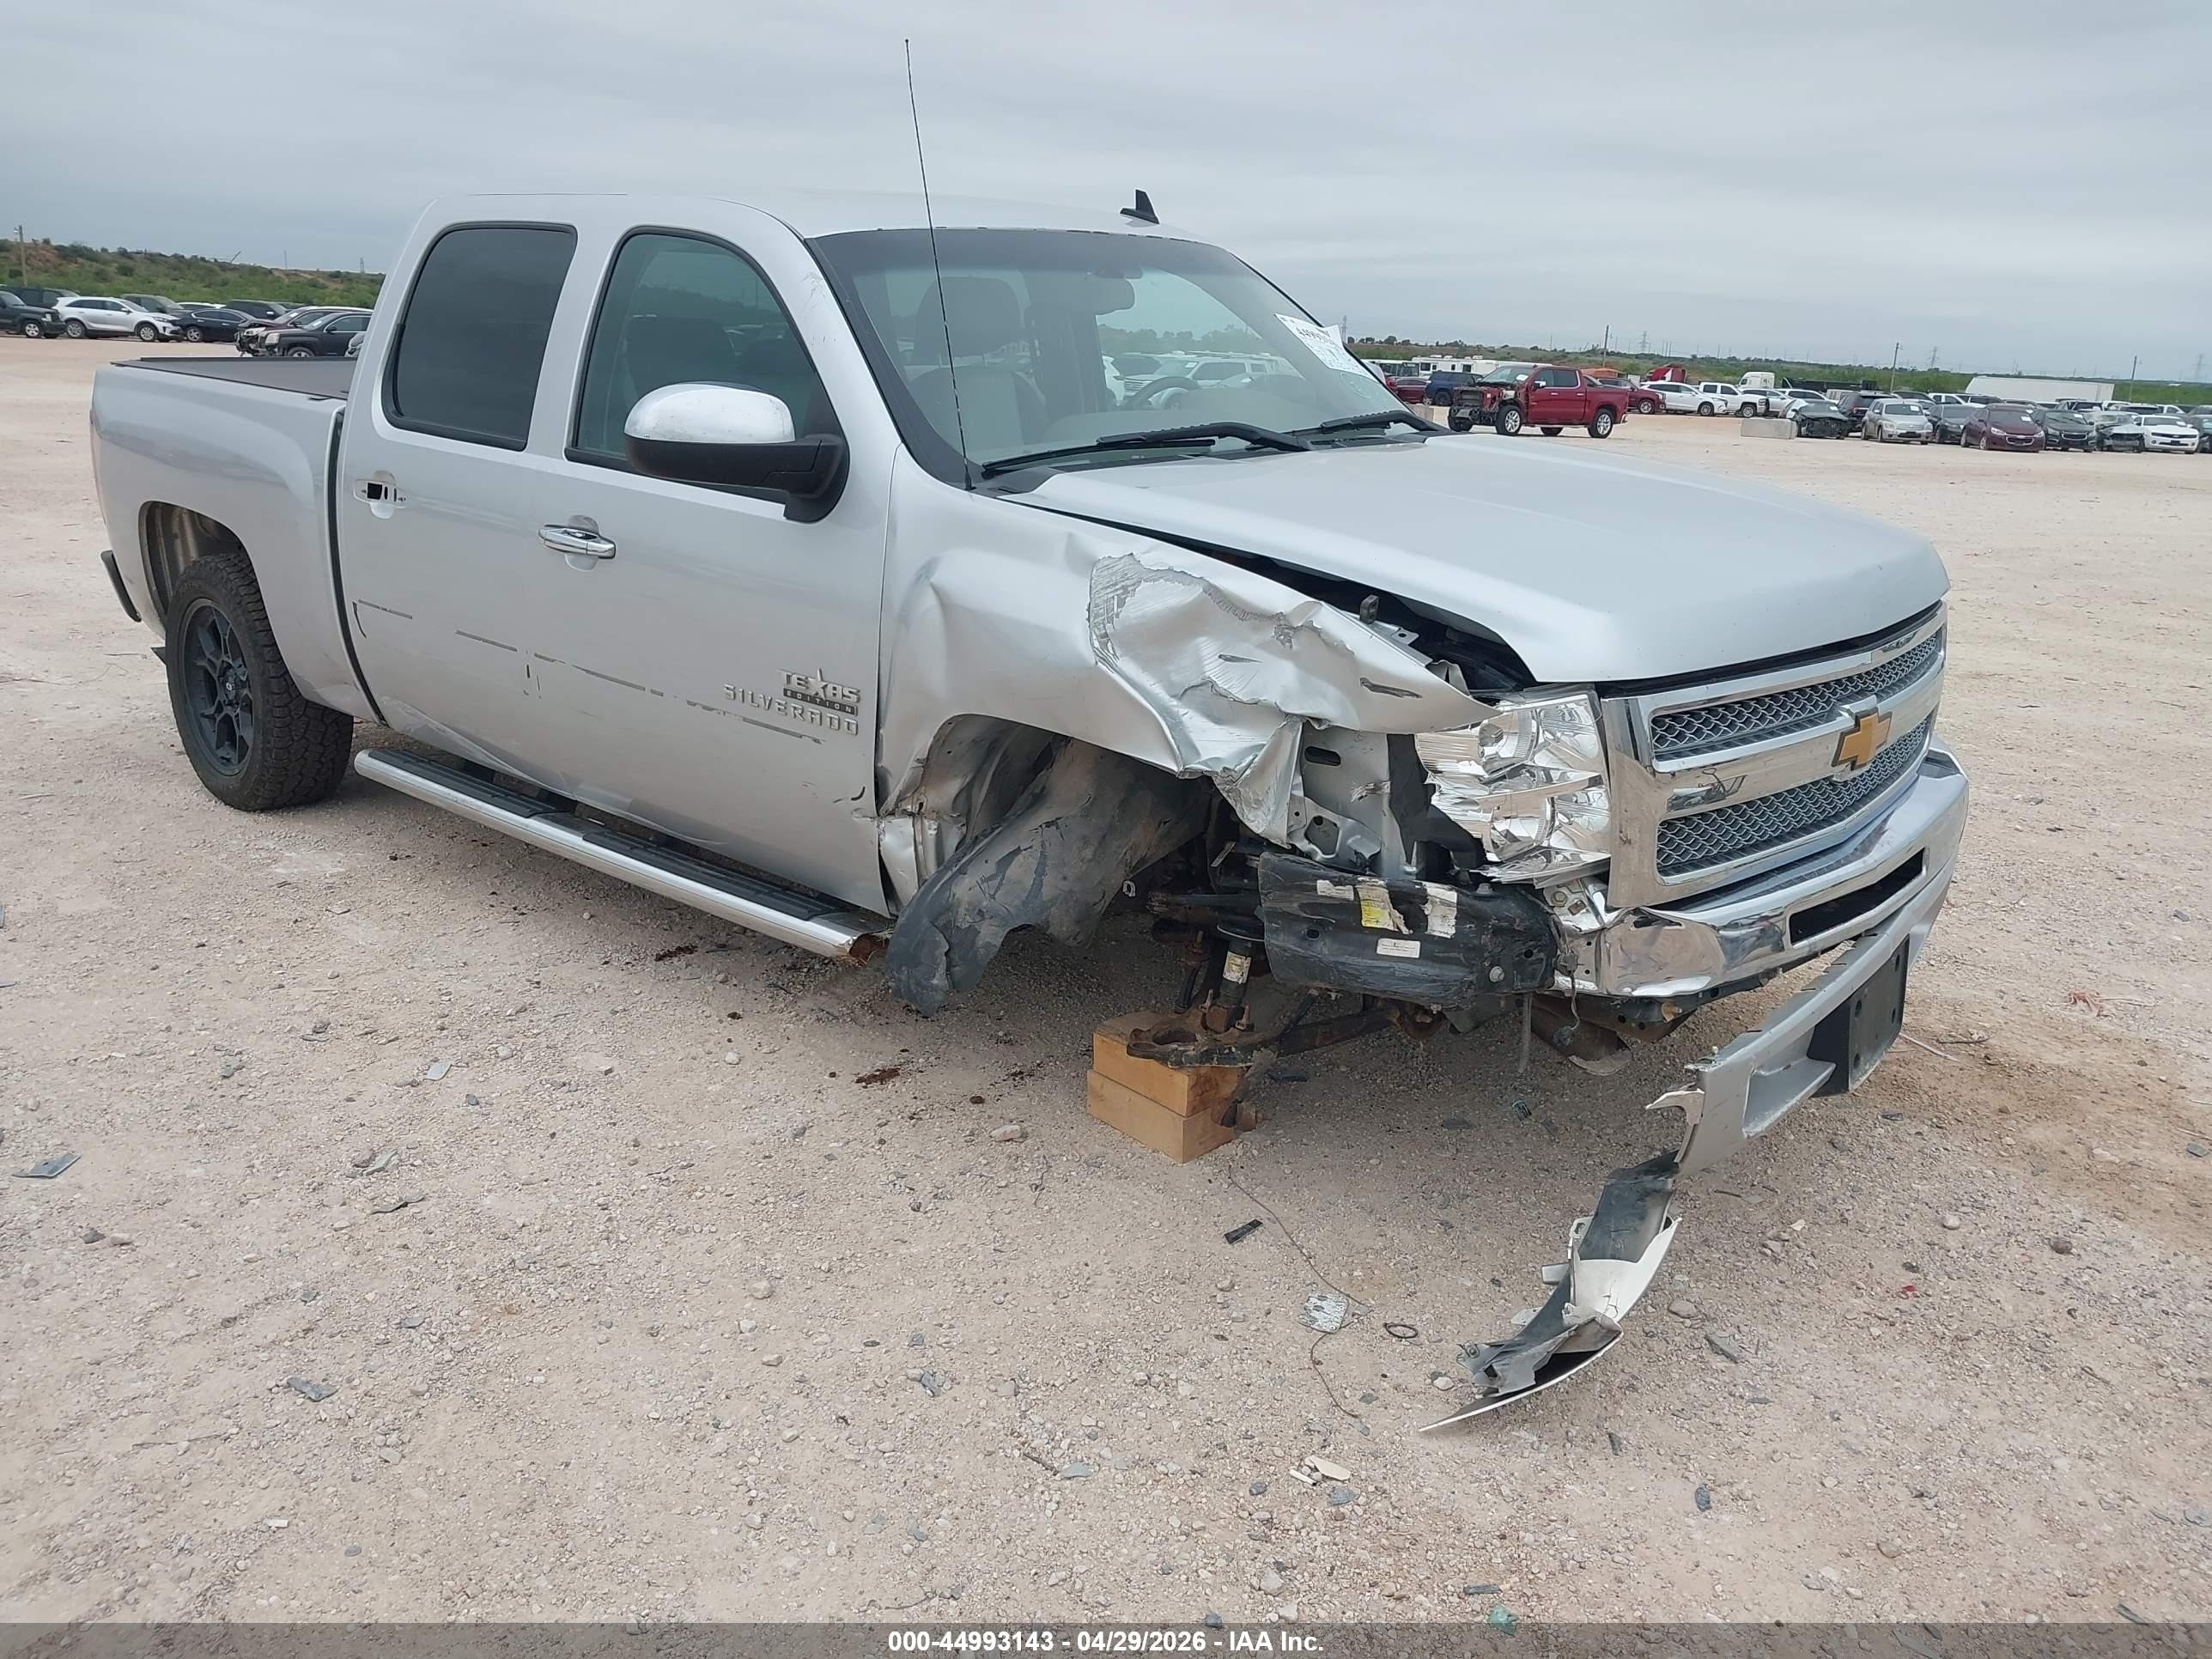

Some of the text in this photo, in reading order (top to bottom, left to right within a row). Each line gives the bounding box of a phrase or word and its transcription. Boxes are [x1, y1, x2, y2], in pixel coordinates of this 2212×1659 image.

[779, 666, 861, 702] TEXAS
[785, 690, 853, 714] EDITION
[723, 684, 859, 735] SILVERADO
